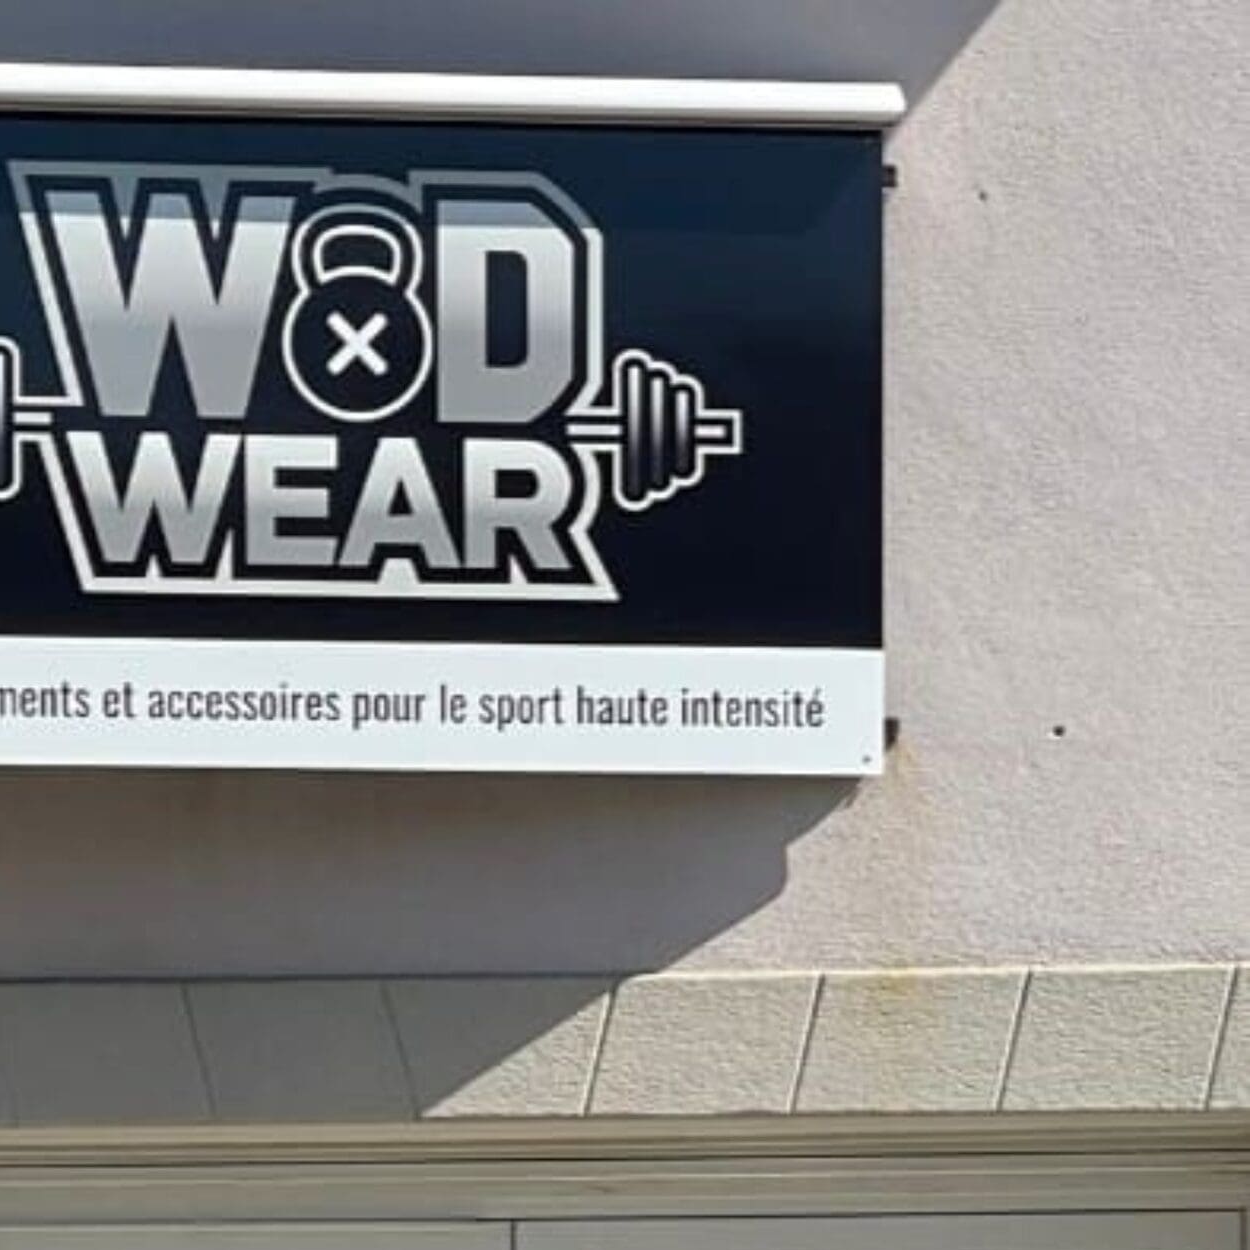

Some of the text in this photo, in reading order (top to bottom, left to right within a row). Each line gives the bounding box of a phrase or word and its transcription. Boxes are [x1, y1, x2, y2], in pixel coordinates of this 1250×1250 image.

[70, 431, 570, 570] WEAR
[102, 681, 136, 718] et
[148, 682, 340, 721] accessoires
[351, 688, 425, 729] pour
[441, 684, 467, 723] le
[479, 686, 563, 731] sport
[577, 686, 668, 726] haute
[681, 687, 824, 728] intensité
